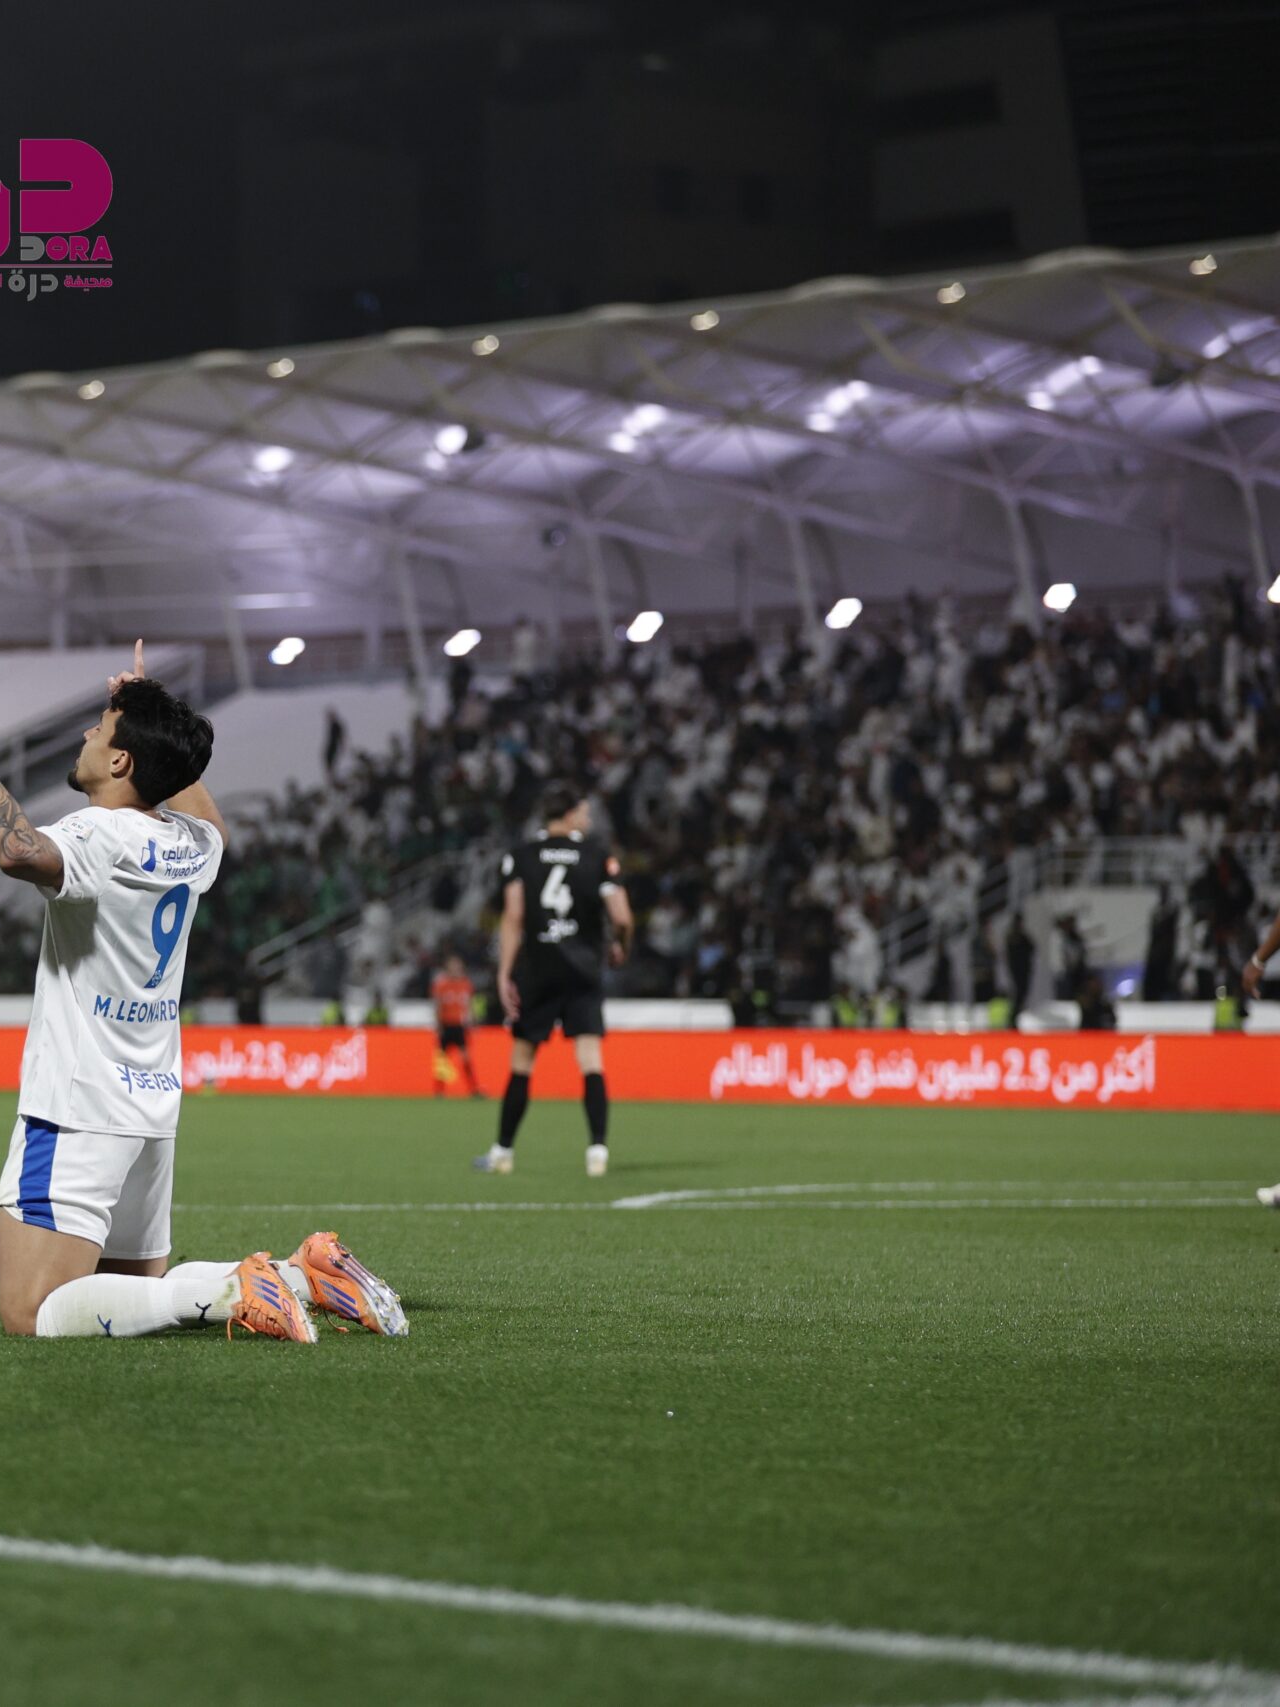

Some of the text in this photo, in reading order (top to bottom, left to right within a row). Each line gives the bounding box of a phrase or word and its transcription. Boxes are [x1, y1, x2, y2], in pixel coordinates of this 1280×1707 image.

[540, 864, 573, 918] 4
[144, 883, 190, 988] 9
[710, 1033, 1157, 1102] أكثر من 2.5 مليون فندق حول العالم
